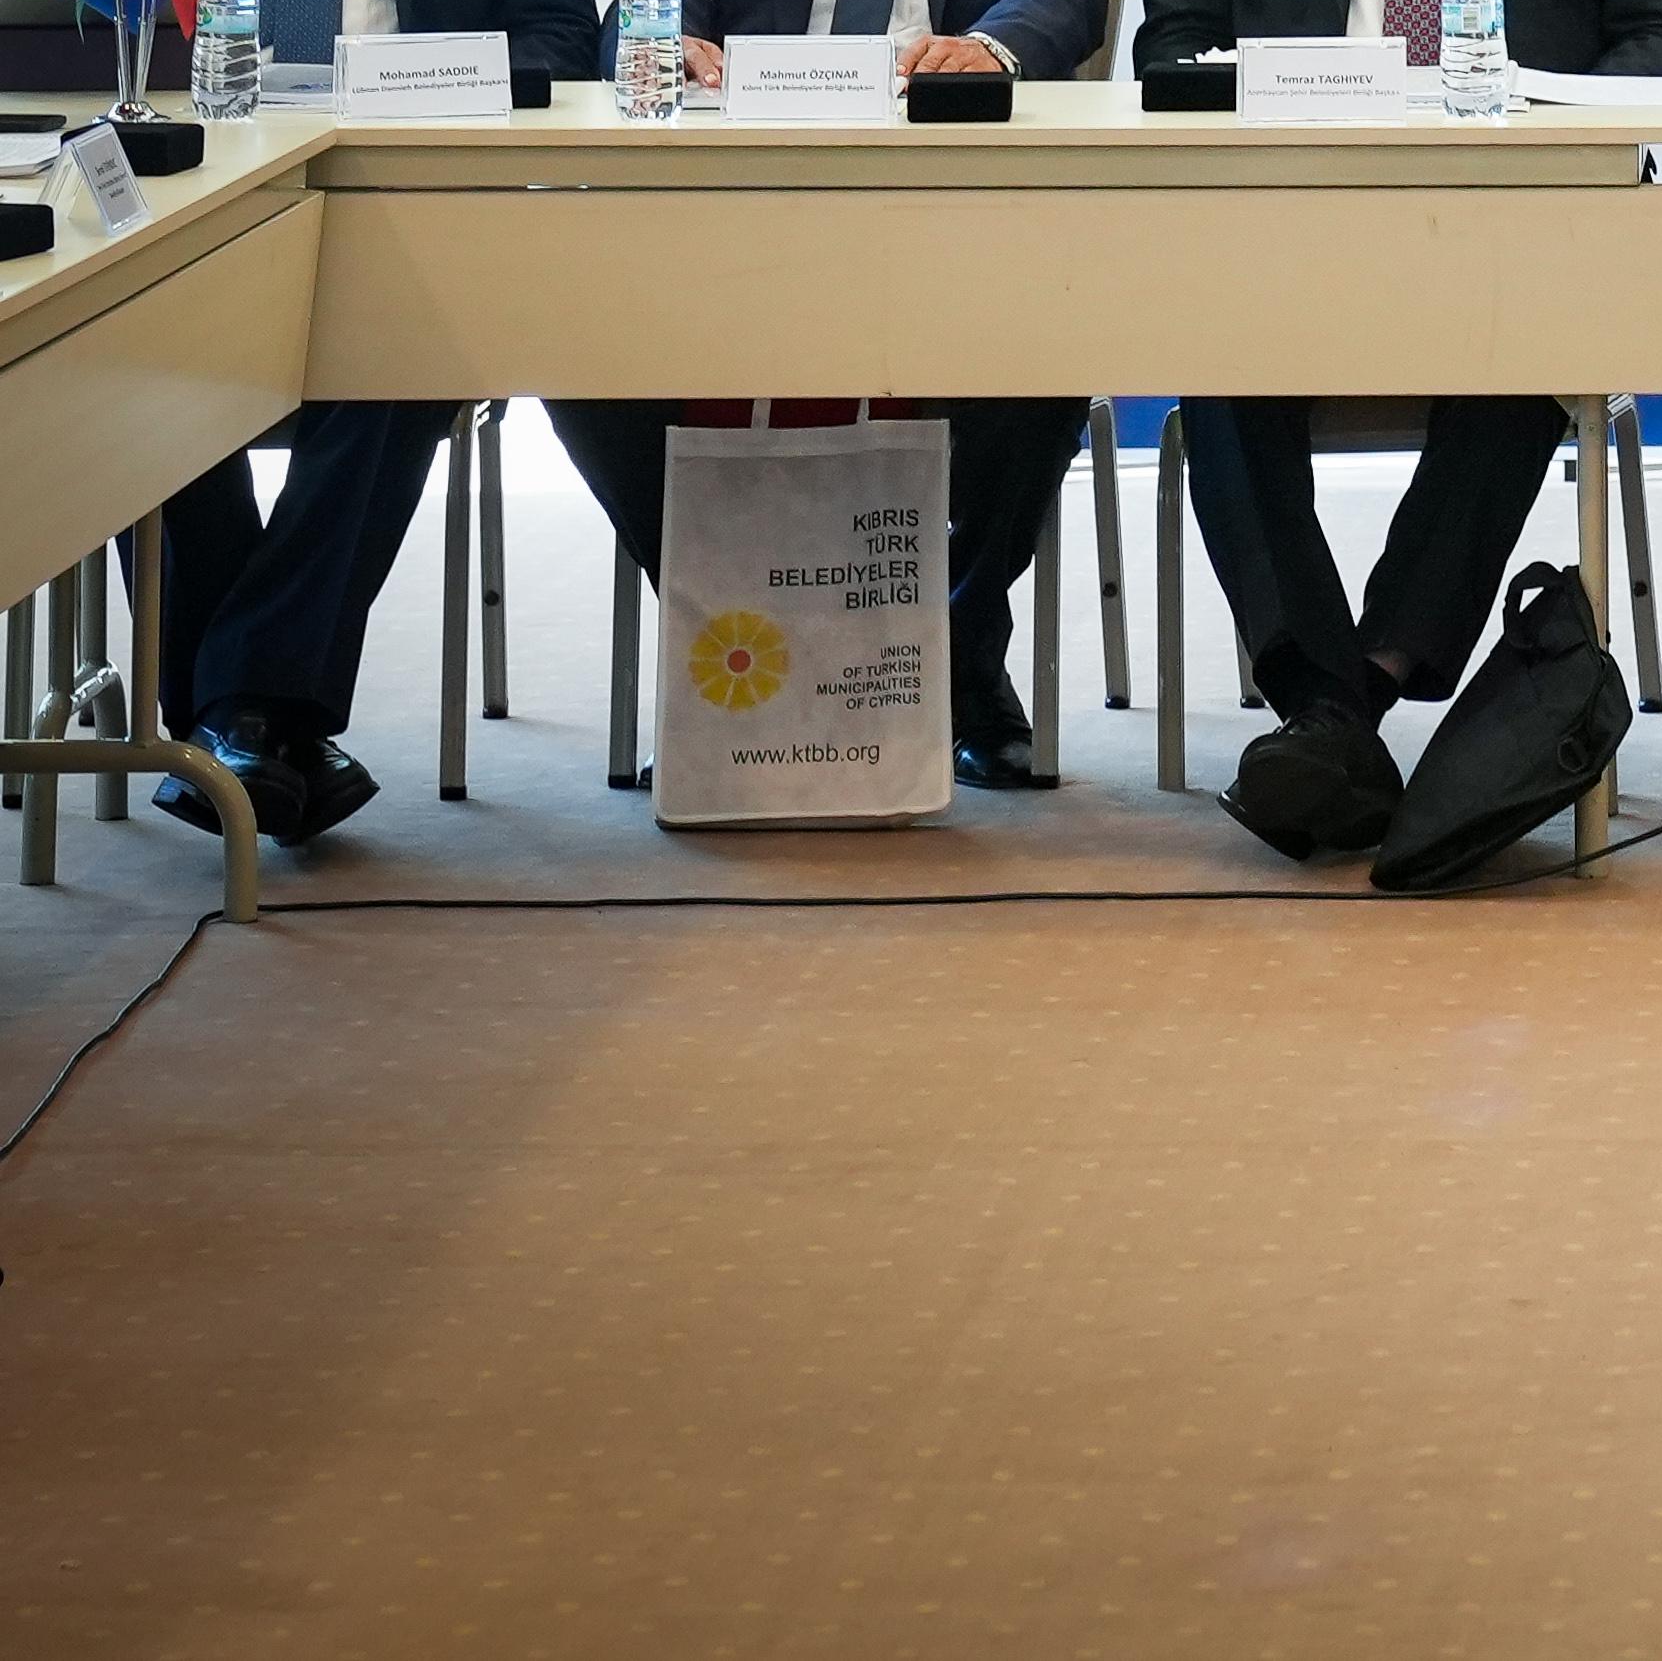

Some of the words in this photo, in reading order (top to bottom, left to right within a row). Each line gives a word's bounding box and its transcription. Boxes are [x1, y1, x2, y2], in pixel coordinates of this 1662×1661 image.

[380, 67, 436, 81] Mohamad
[438, 65, 480, 78] SADDIE
[760, 70, 806, 80] Mahmut
[809, 69, 859, 81] ÖZÇINAR
[1275, 74, 1315, 84] Temraz
[1318, 74, 1374, 85] TAGHIYEV
[853, 509, 920, 532] KIBRIS
[866, 533, 920, 556] TÜRK
[769, 561, 920, 588] BELEDİYELER
[846, 582, 919, 610] BİRLİĞİ
[880, 645, 921, 659] UNION
[843, 667, 862, 679] OF
[866, 659, 921, 678] TURKISH
[816, 676, 921, 696] MUNICIPALITIES
[846, 698, 864, 710] OF
[869, 693, 921, 709] CYPRUS
[732, 744, 880, 766] www.ktbb.org
